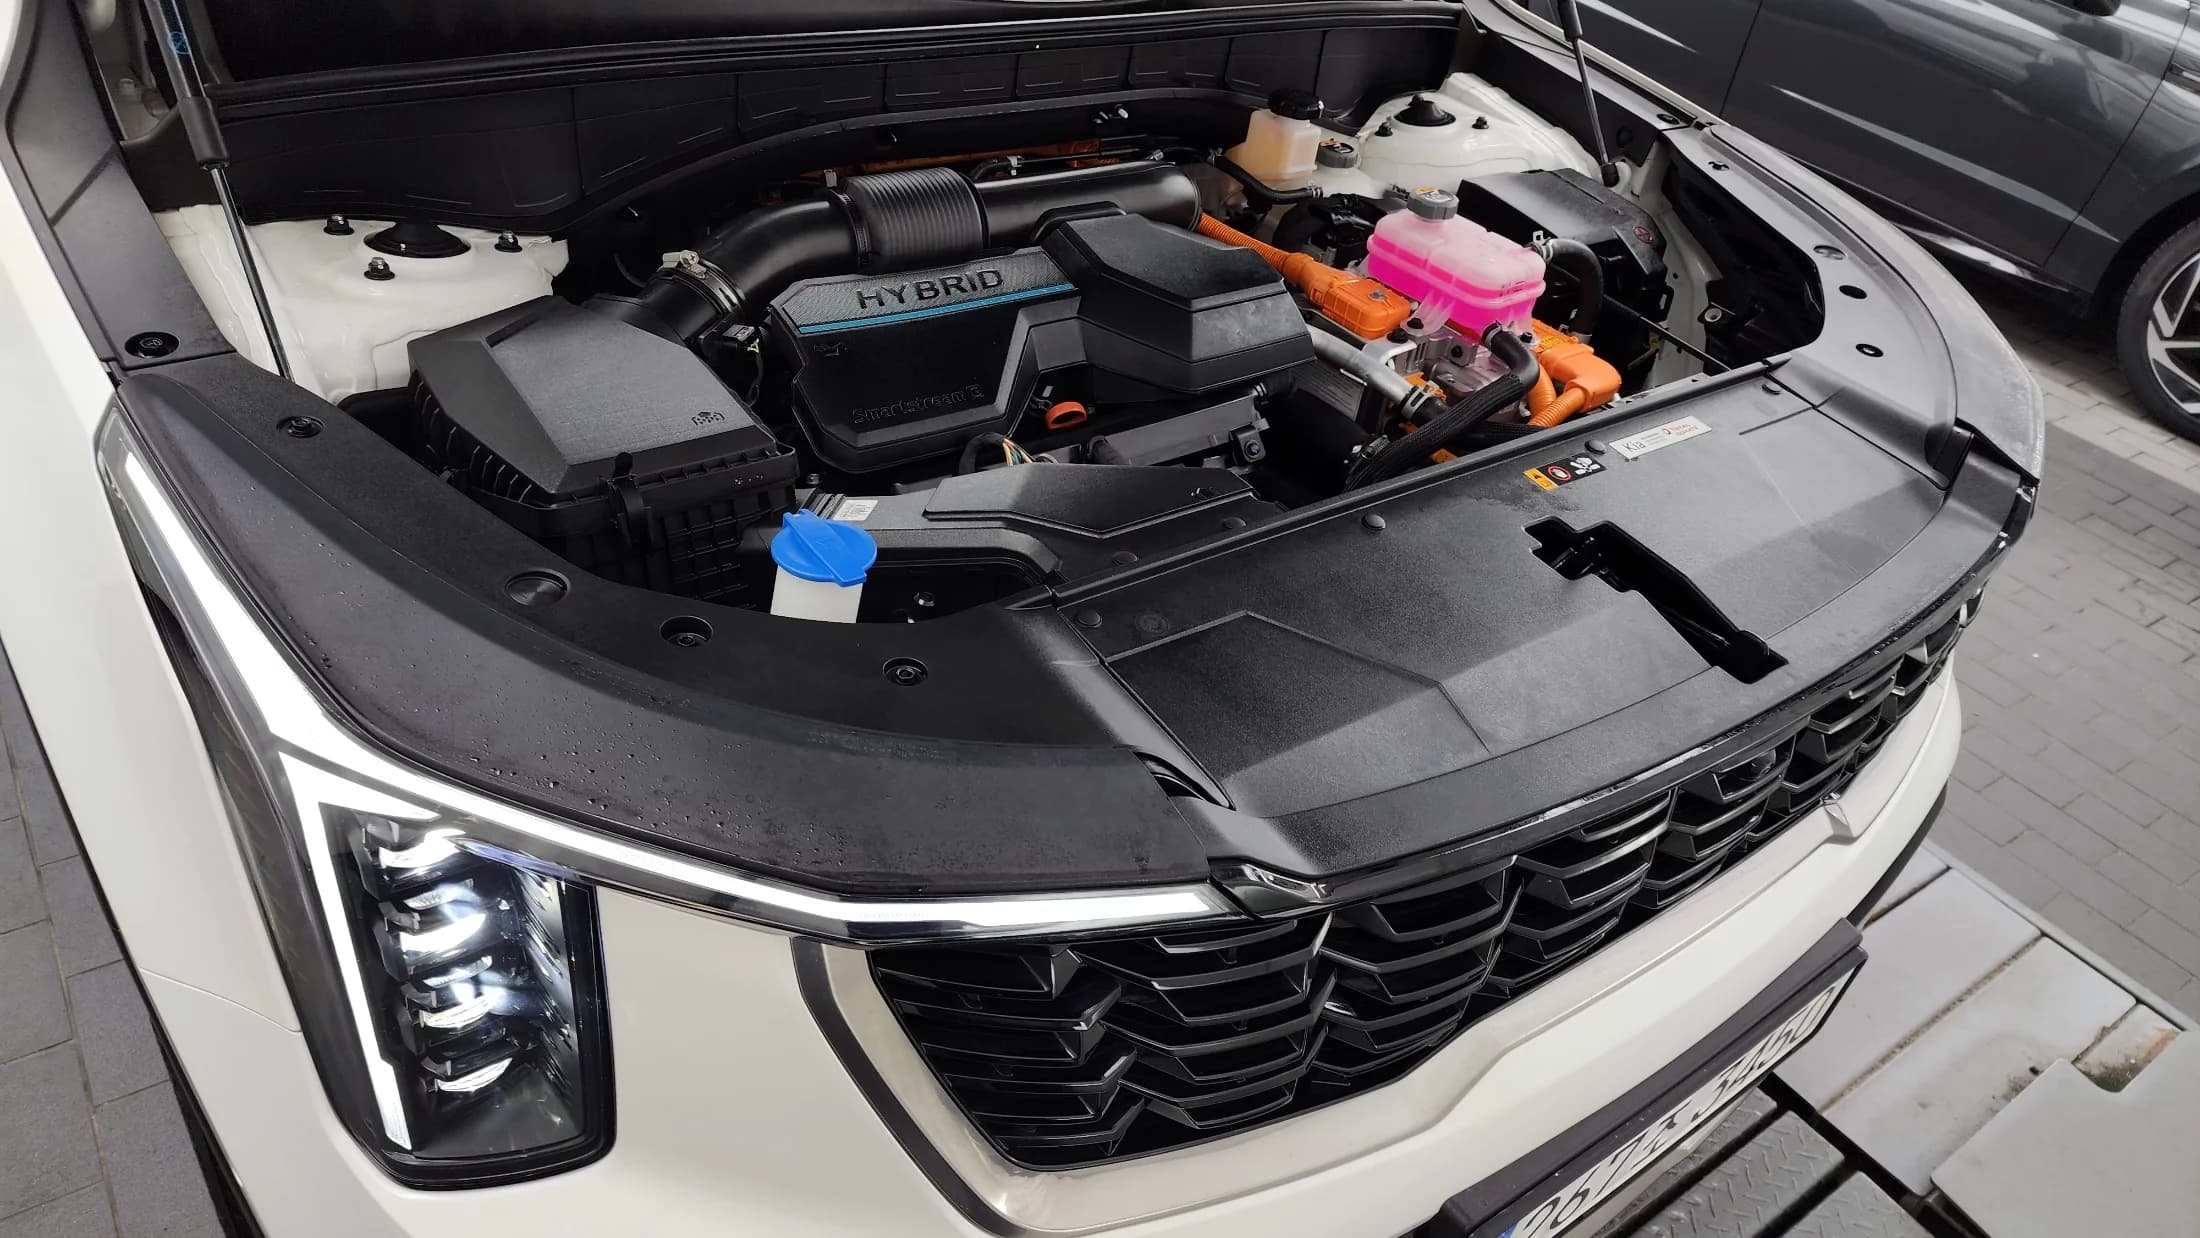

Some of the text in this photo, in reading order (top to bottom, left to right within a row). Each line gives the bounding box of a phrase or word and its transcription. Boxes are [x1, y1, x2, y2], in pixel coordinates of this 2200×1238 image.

[856, 268, 1004, 310] HYBRID
[852, 390, 967, 424] Smartstream
[1622, 440, 1647, 453] Kia
[1690, 985, 1836, 1123] 3450
